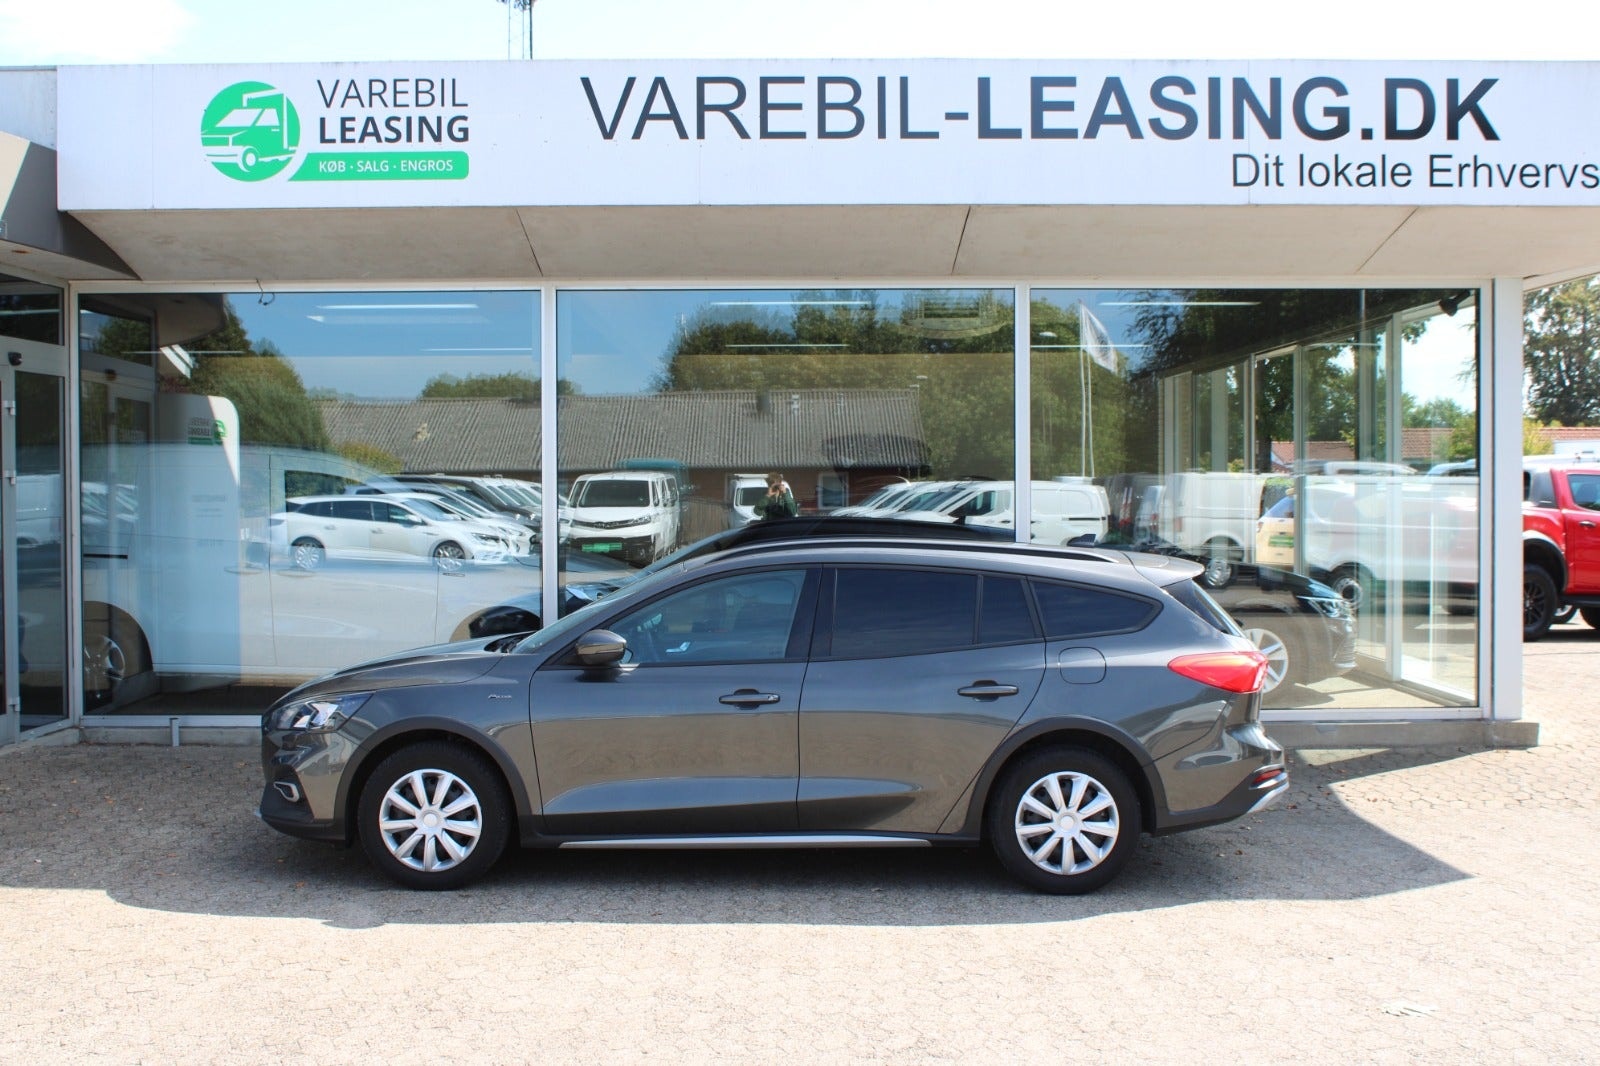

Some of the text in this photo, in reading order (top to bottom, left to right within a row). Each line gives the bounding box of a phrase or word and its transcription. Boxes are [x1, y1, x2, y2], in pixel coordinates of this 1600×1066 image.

[316, 78, 469, 109] VAREBIL
[579, 75, 1501, 142] VAREBIL-LEASING.DK
[319, 115, 470, 144] LEASING
[319, 159, 454, 173] KØB SALG ENGROS
[1232, 153, 1600, 189] Dit lokale Erhvervs
